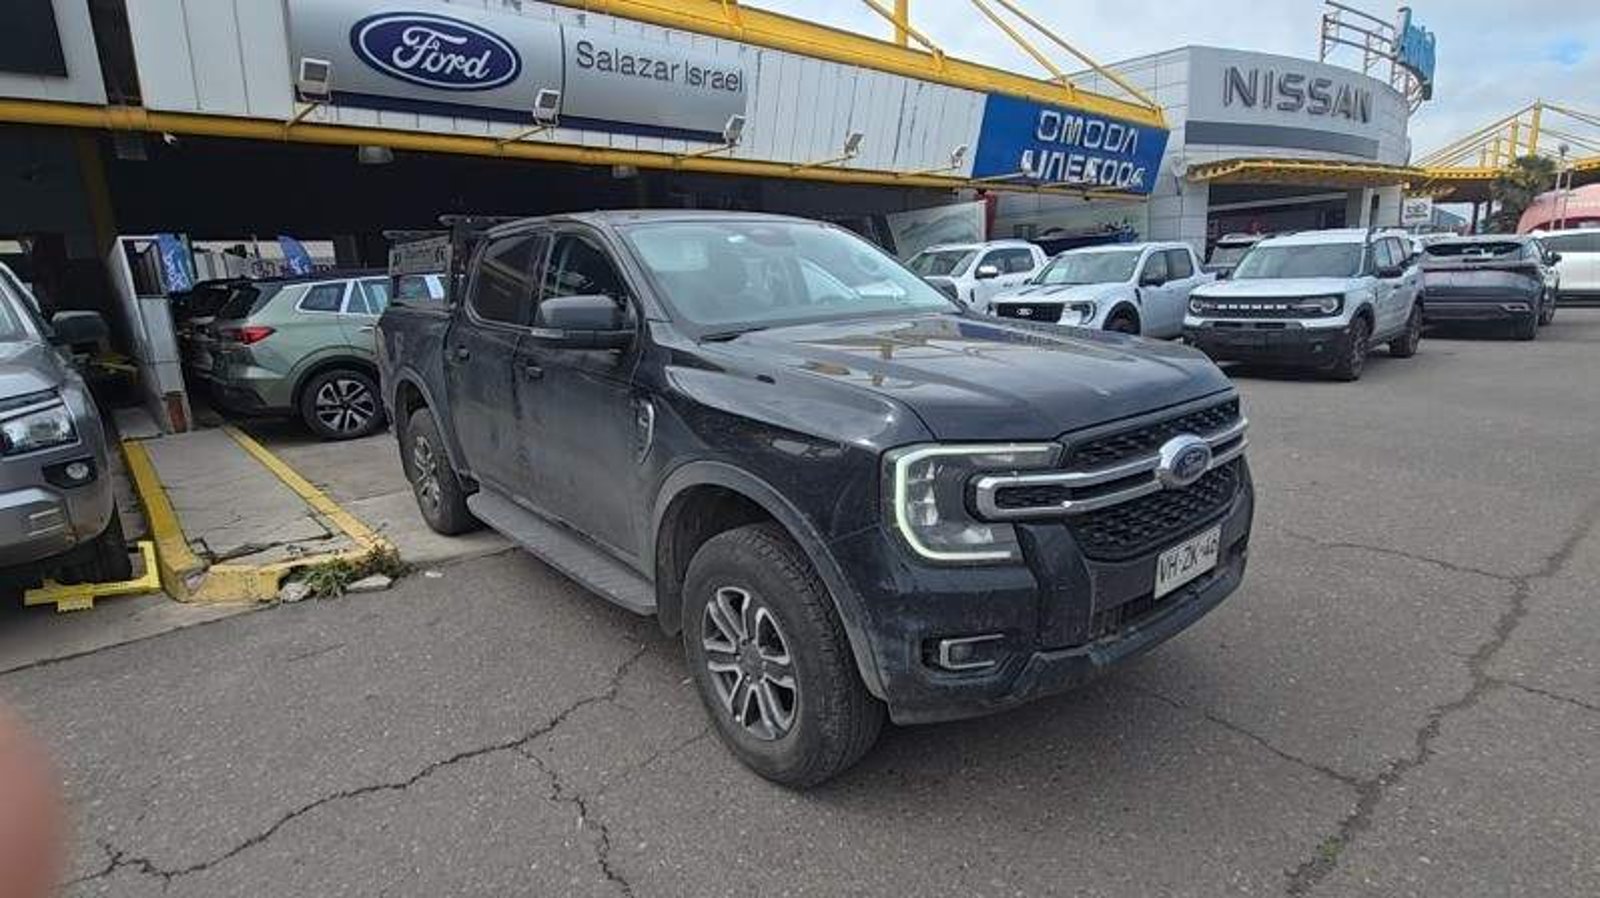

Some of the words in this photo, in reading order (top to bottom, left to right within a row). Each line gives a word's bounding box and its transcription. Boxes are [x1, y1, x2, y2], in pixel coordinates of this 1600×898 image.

[393, 26, 491, 79] Ford
[576, 40, 680, 82] Salazar
[685, 60, 743, 93] Israel
[1223, 65, 1370, 124] NISSAN
[1037, 109, 1140, 154] OMODA
